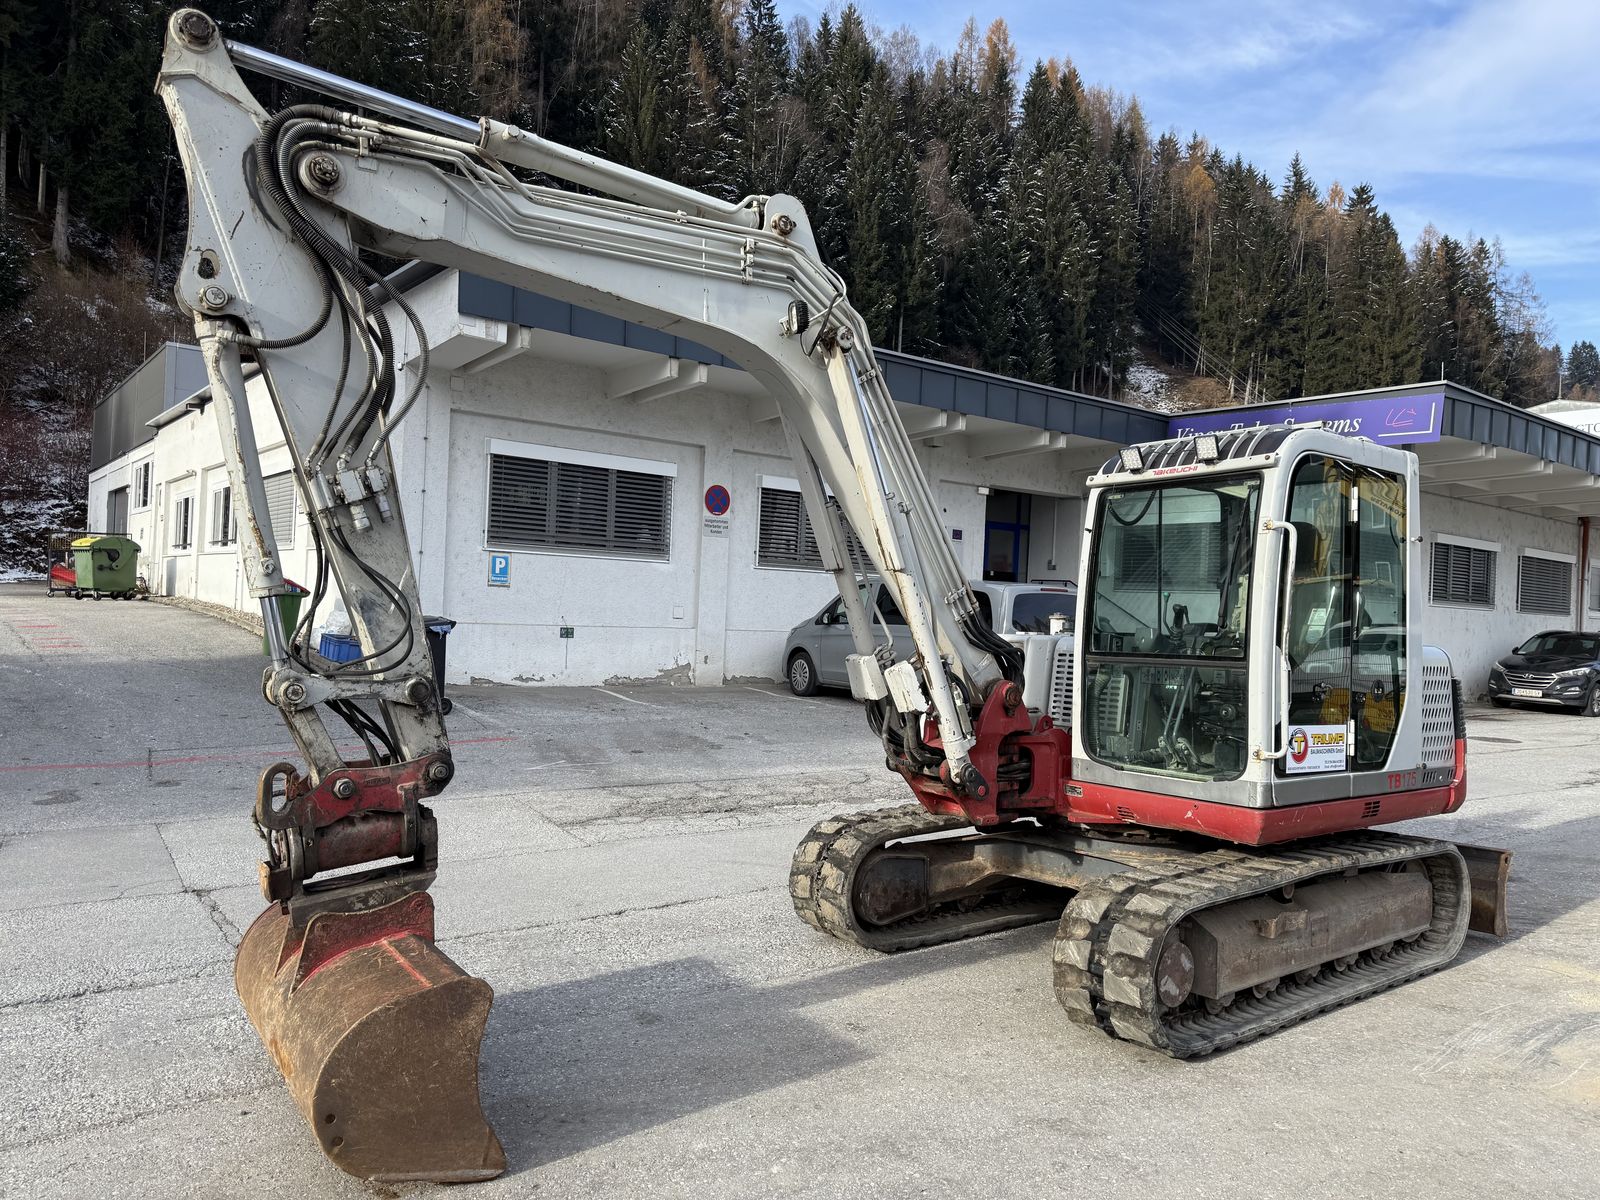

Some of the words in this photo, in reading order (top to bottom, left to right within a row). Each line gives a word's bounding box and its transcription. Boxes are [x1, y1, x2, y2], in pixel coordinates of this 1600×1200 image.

[1152, 465, 1198, 476] TAKEUCHI
[495, 557, 506, 574] P
[1388, 772, 1416, 790] TB175
